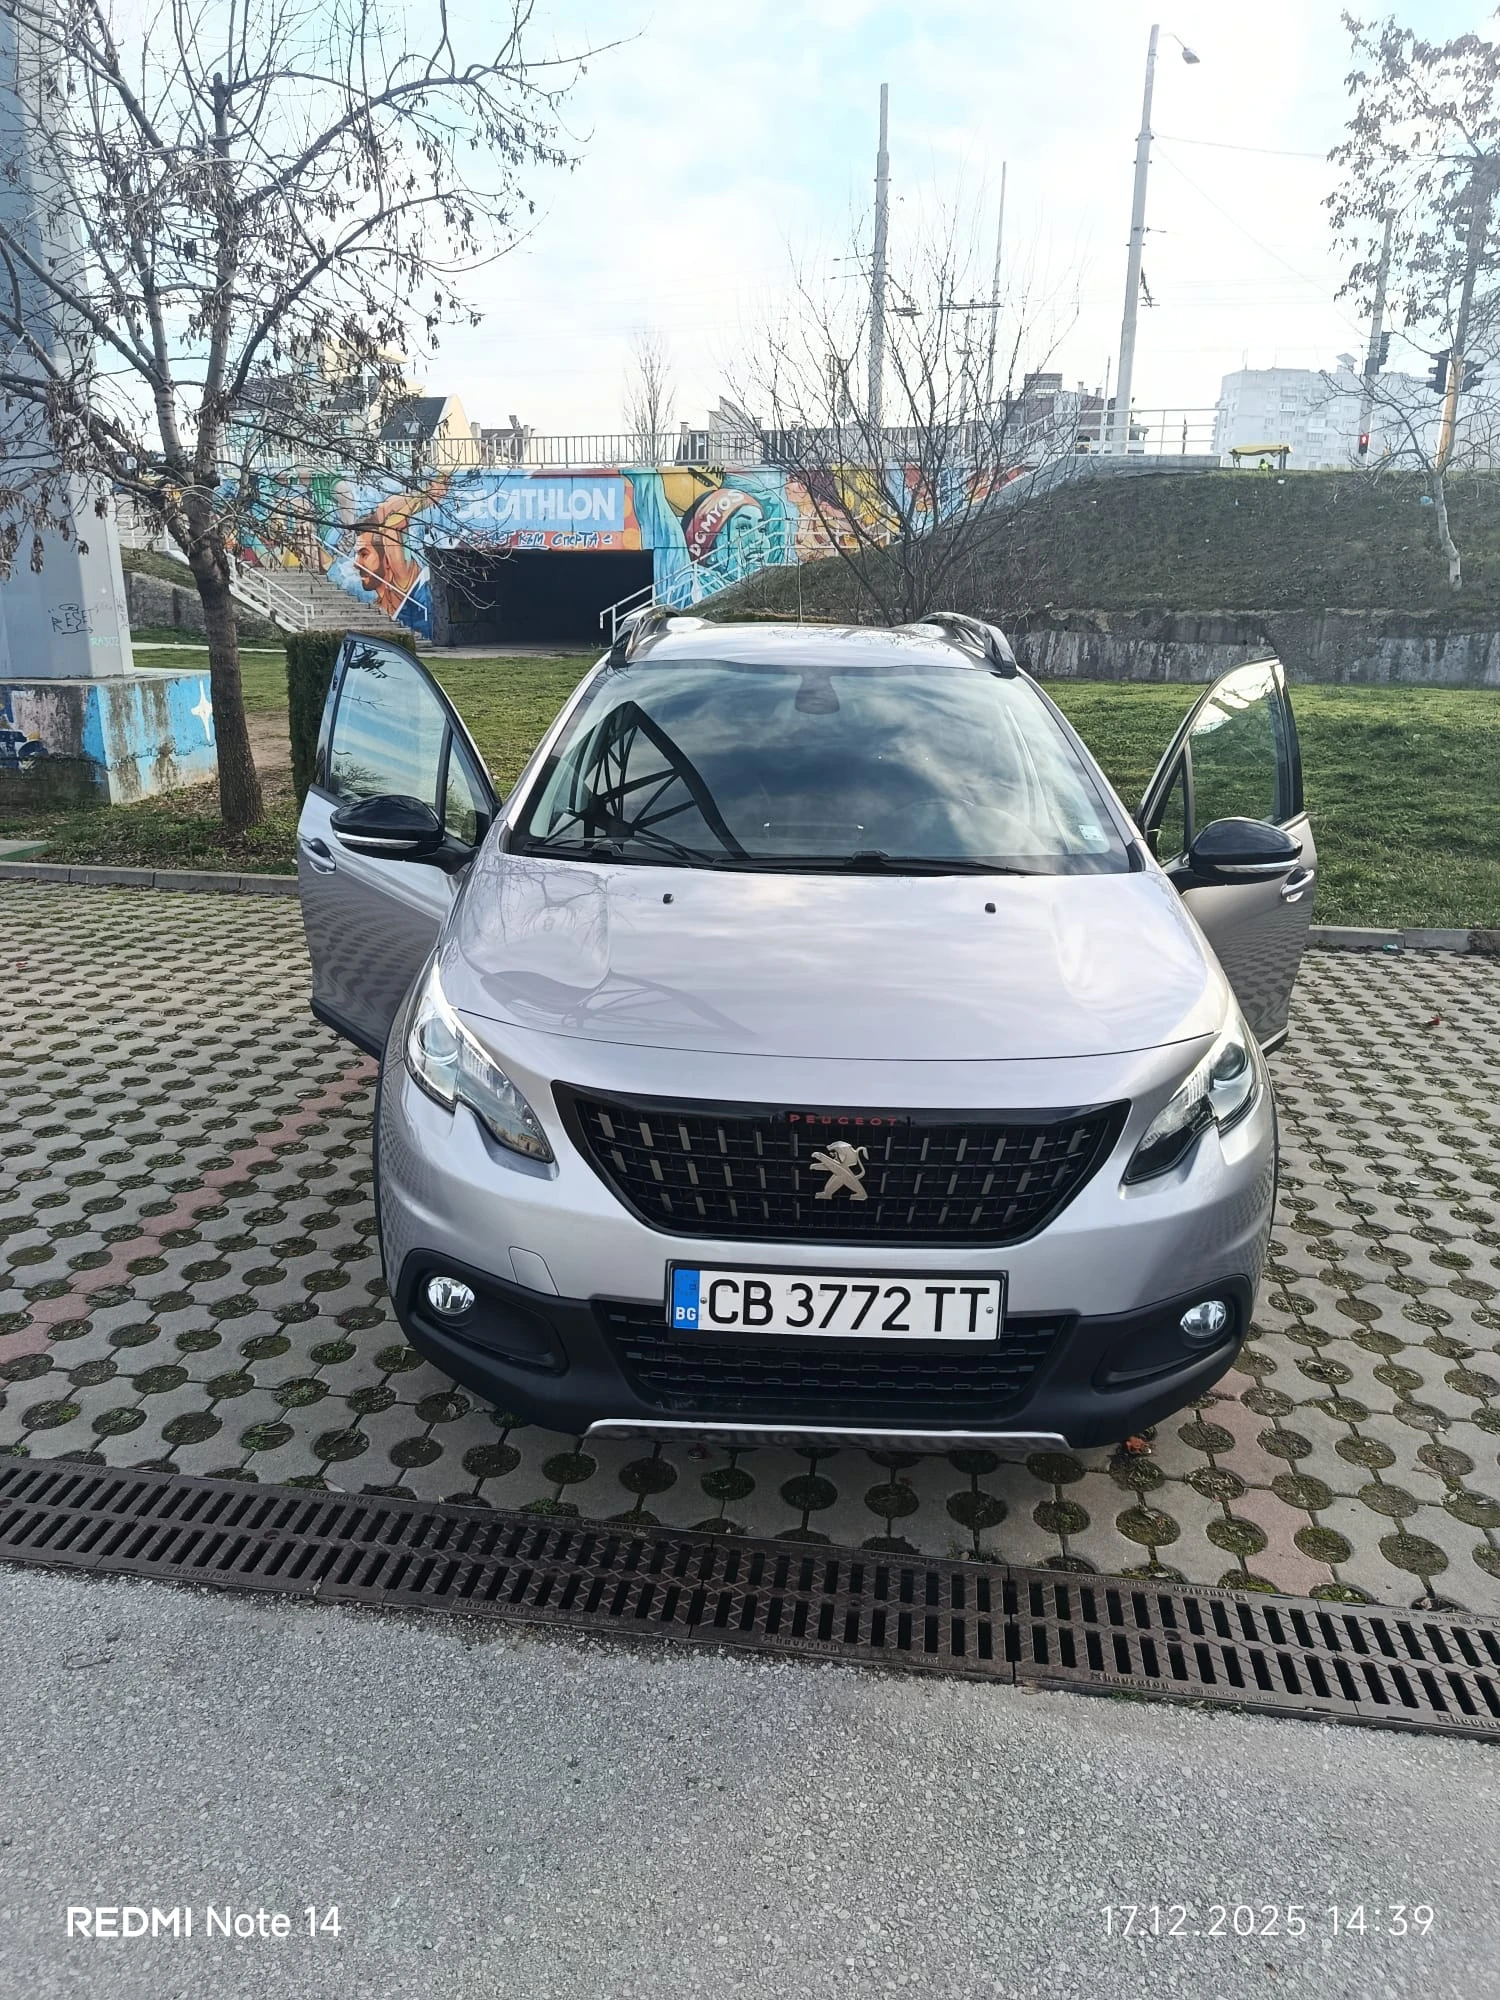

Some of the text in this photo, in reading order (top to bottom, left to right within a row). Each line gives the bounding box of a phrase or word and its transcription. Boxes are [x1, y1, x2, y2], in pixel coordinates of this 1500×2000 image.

[789, 1114, 897, 1126] PEUGEOT
[675, 1279, 990, 1333] BG CB 3772 TT
[1451, 1714, 1500, 1729] haura
